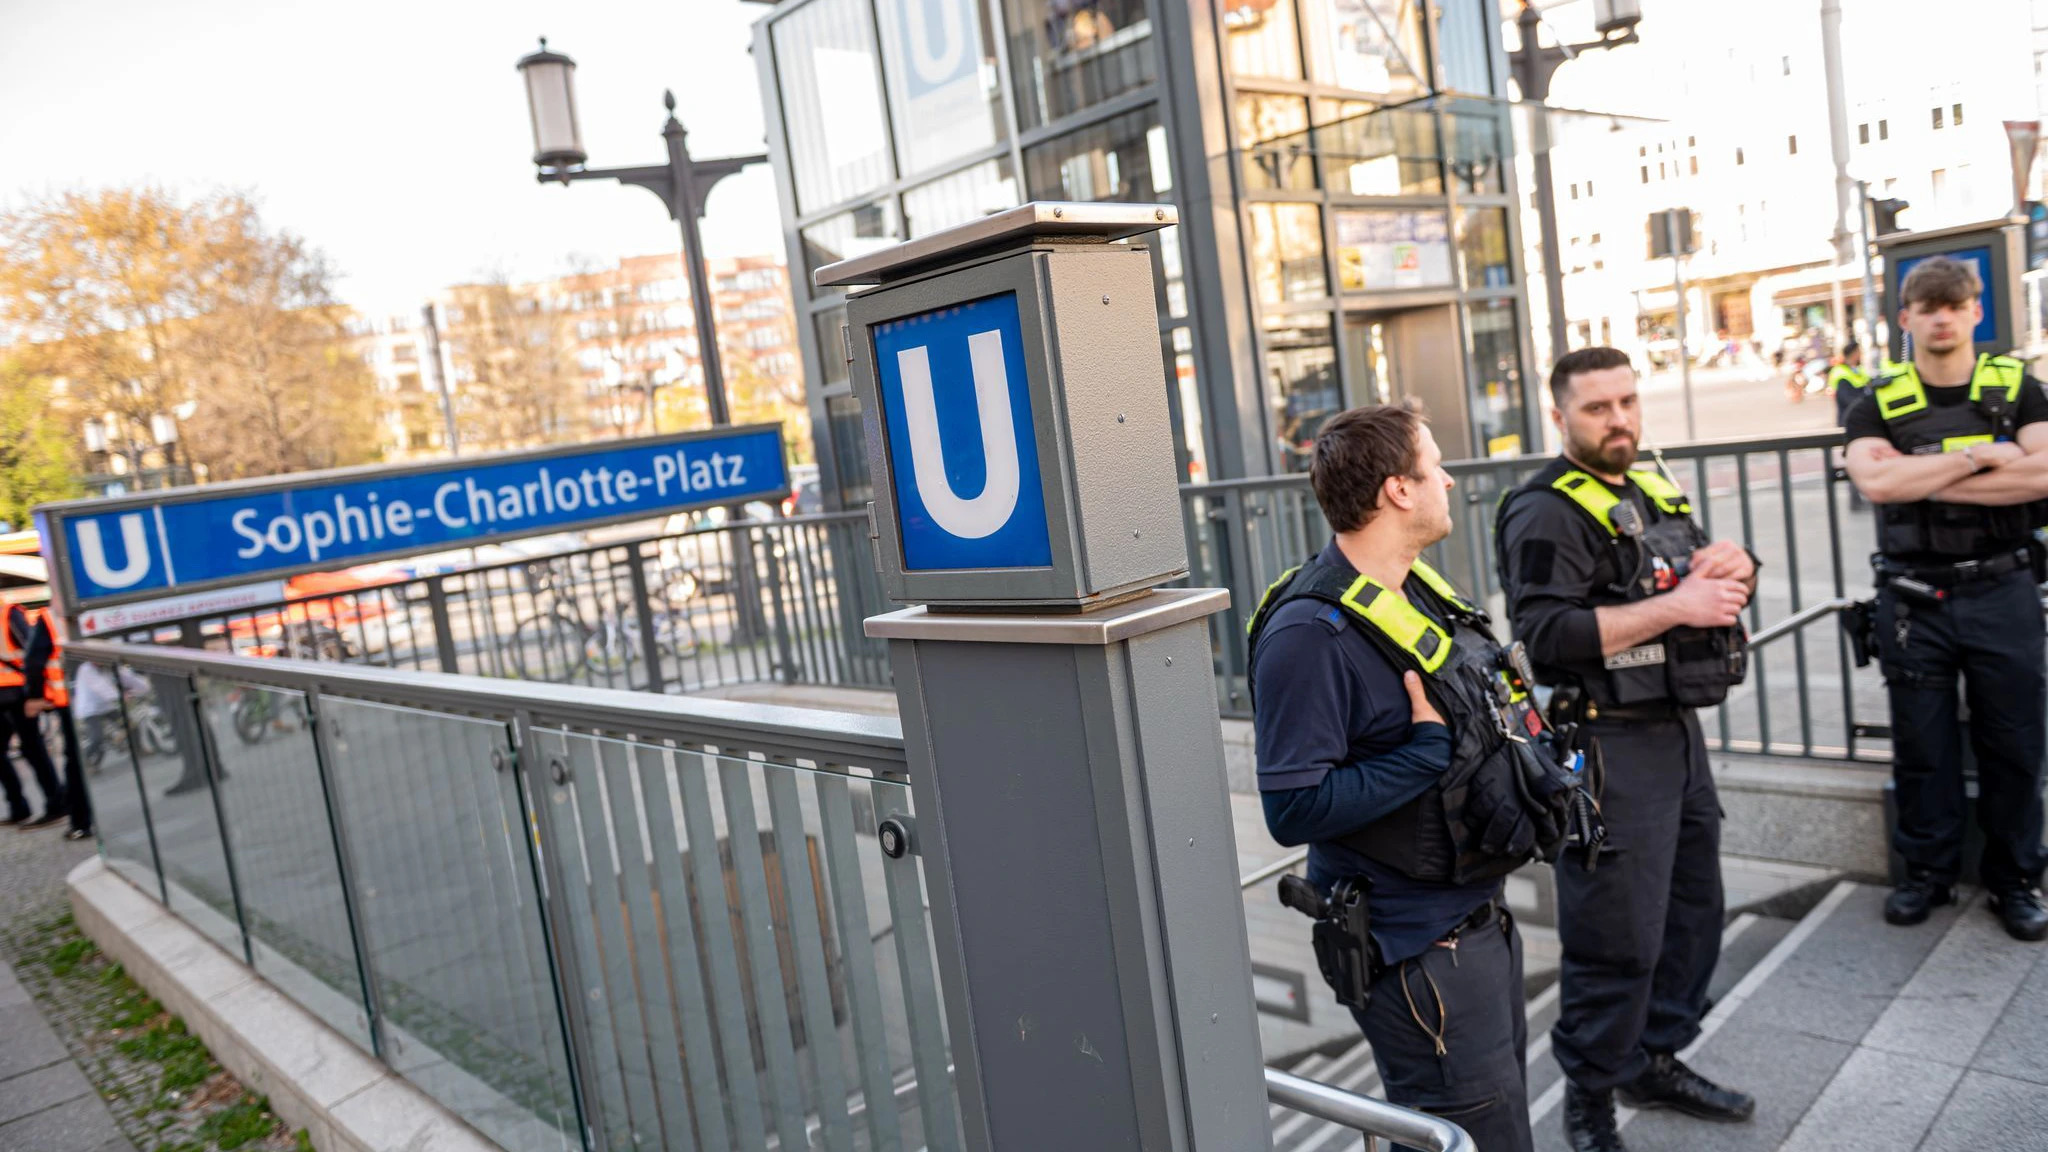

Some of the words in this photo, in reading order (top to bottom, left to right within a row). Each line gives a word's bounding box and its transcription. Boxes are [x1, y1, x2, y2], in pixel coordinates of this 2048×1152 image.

[904, 0, 965, 84] U
[896, 328, 1020, 540] U
[75, 512, 151, 589] U
[231, 449, 748, 563] Sophie-Charlotte-Platz
